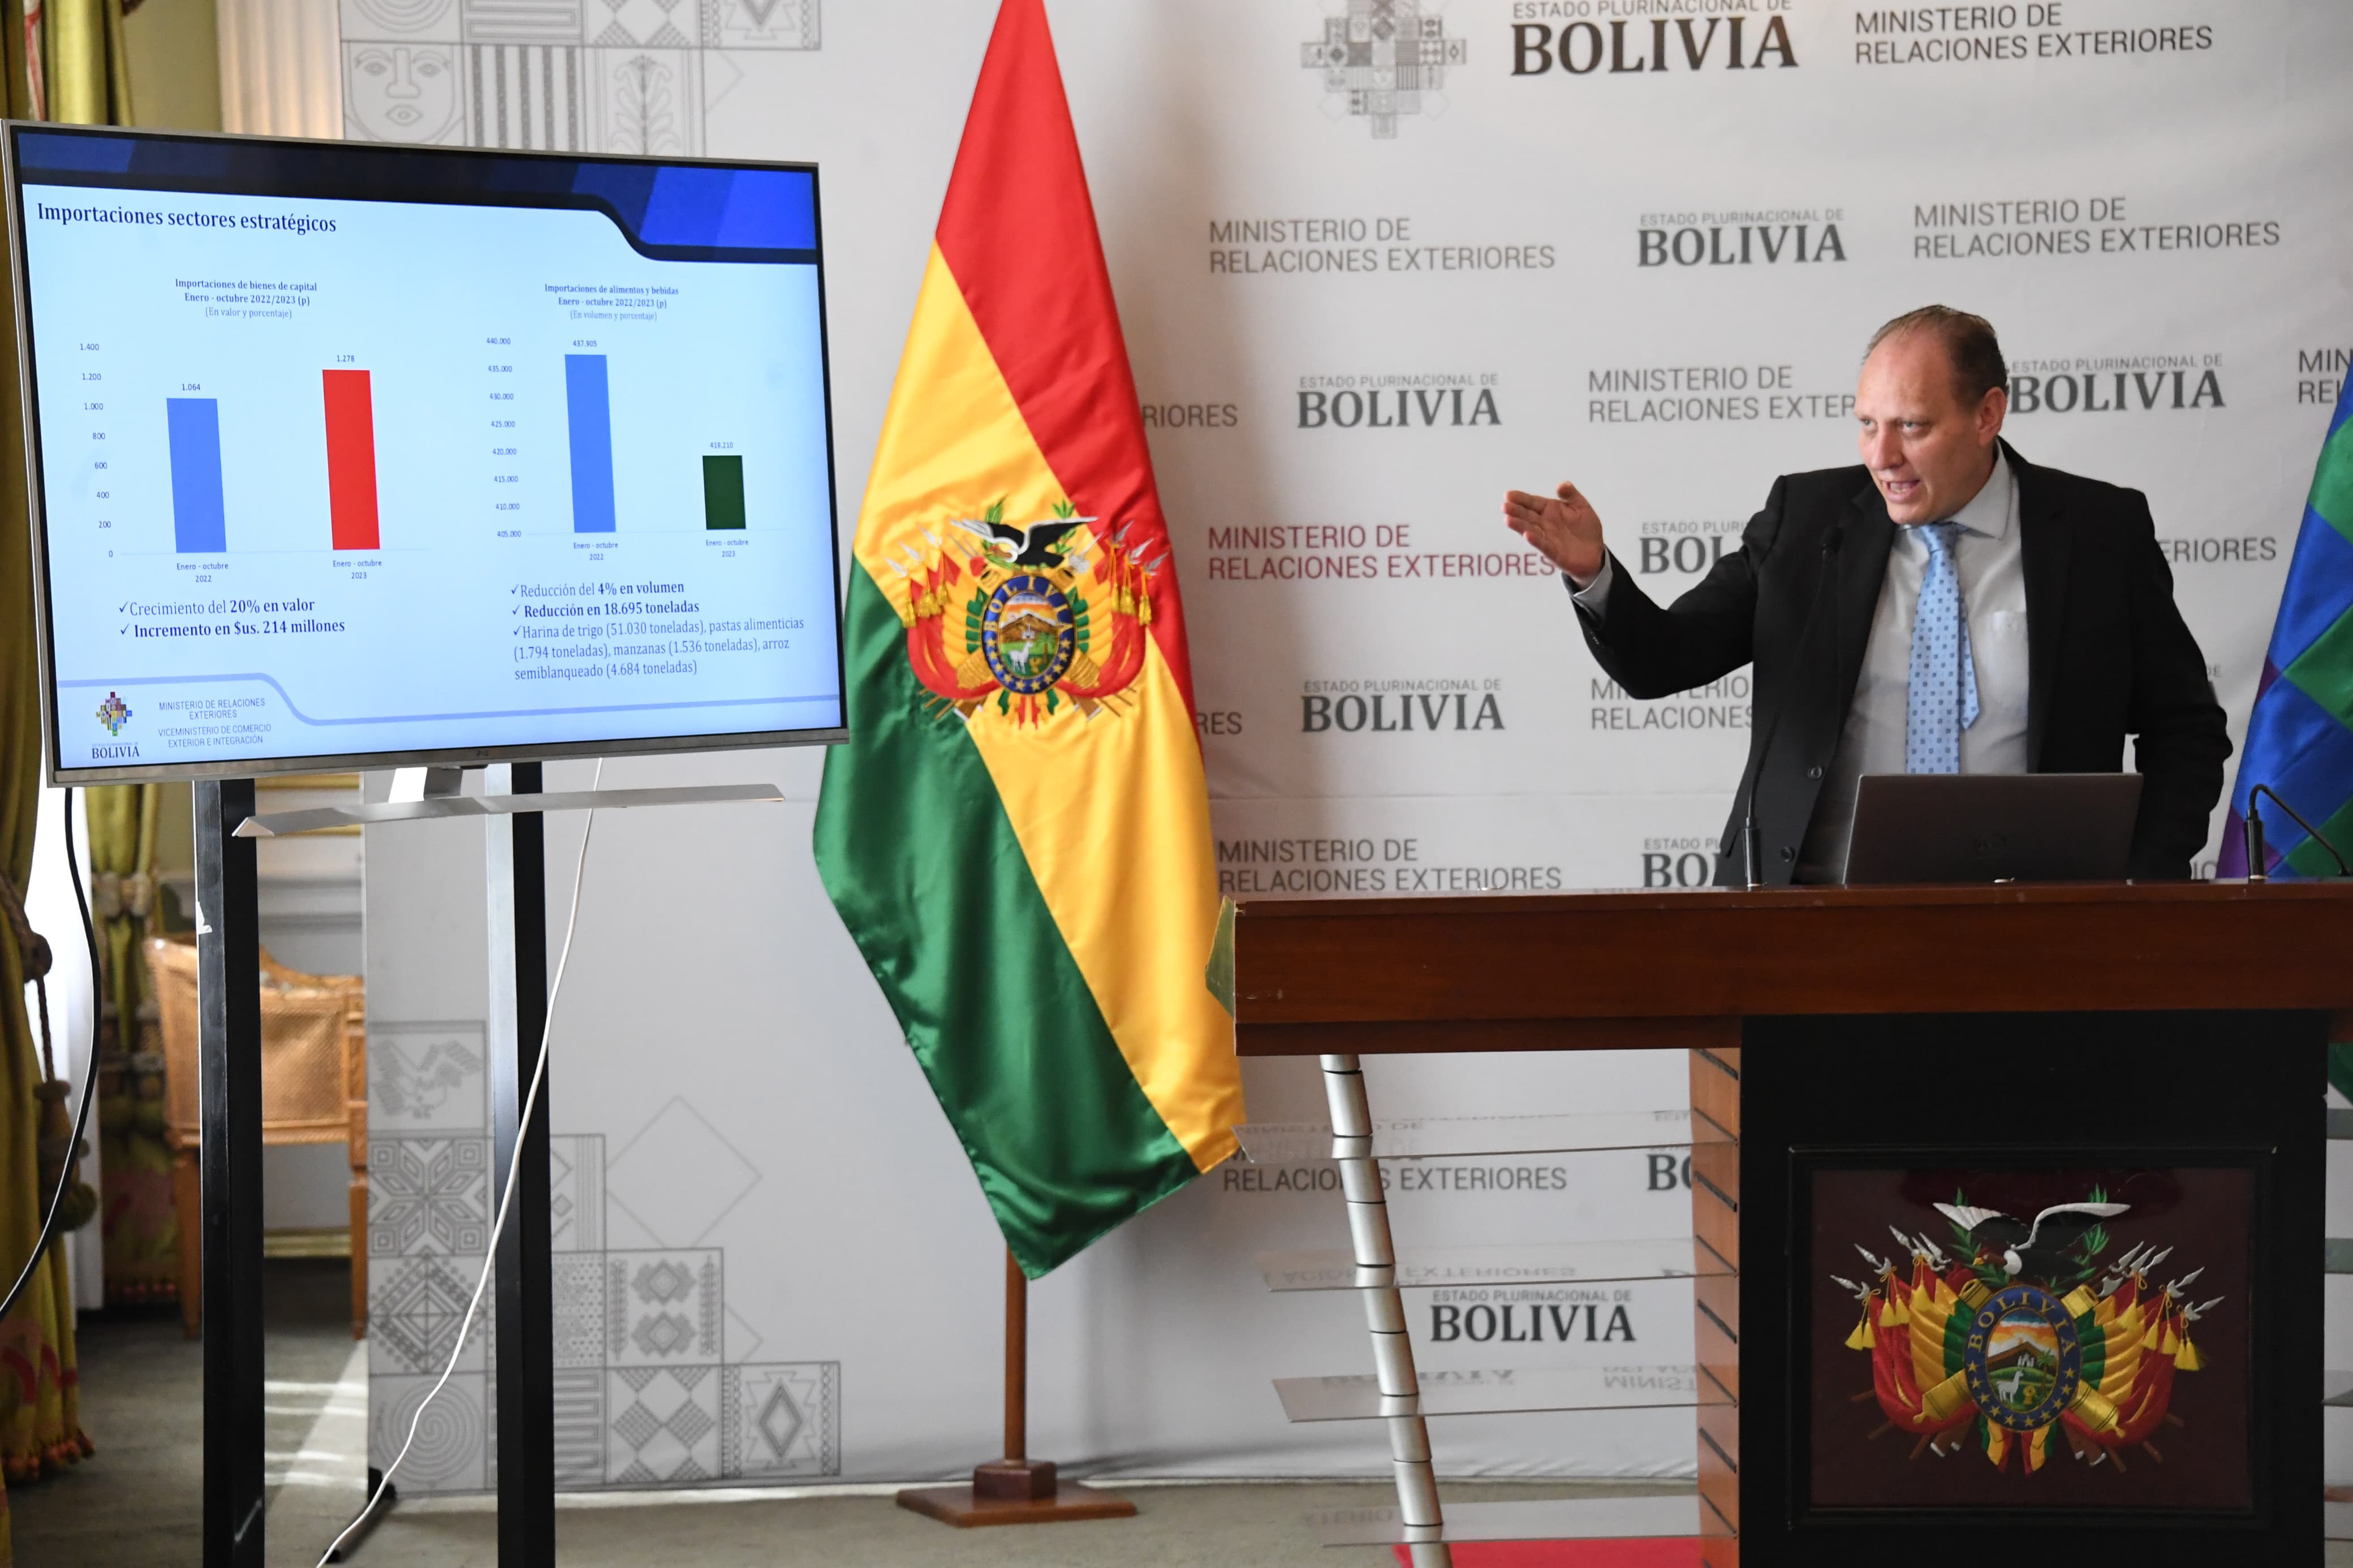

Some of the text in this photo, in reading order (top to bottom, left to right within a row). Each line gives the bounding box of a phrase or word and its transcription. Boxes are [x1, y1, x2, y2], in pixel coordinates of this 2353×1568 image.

[1514, 0, 1791, 19] ESTADO PLURINACIONAL DE
[1856, 3, 2061, 34] MINISTERIO DE
[1511, 15, 1799, 76] BOLIVIA
[1856, 25, 2212, 64] RELACIONES EXTERIORES
[38, 203, 335, 235] Importaciones sectores estratégicos
[1640, 208, 1843, 227] ESTADO PLURINACIONAL DE
[1915, 197, 2125, 227] MINISTERIO DE
[1210, 218, 1410, 243] MINISTERIO DE
[1915, 222, 2279, 258] RELACIONES EXTERIORES
[1637, 224, 1847, 267] BOLIVIA
[1210, 245, 1555, 273] RELACIONES EXTERIORES
[175, 278, 317, 293] Importaciones de bienes de capital
[545, 283, 679, 295] Importaciones de alimentos bebidas
[184, 292, 310, 306] Enero octubre 2022/2023 (p)
[558, 297, 667, 309] Enero octubre 2022/2023 (p)
[205, 306, 292, 320] (En valor porcentaje)
[583, 310, 657, 322] volumen porcentaje)
[2012, 354, 2222, 373] ESTADO PLURINACIONAL DE
[1300, 373, 1498, 388] ESTADO PLURINACIONAL DE
[1589, 366, 1791, 392] MINISTERIO DE
[2009, 369, 2226, 414] BOLIVIA
[84, 402, 104, 411] 1.000
[1297, 388, 1502, 429] BOLIVIA
[1589, 397, 1759, 422] RELACIONES
[1209, 525, 1410, 549] MINISTERIO DE
[1643, 521, 1699, 534] ESTADO
[202, 561, 229, 570] octubre
[357, 559, 382, 567] octubre
[1210, 553, 1555, 580] RELACIONES EXTERIORES
[195, 574, 212, 583] 2022
[520, 581, 684, 598] Reducción del 4% en volumen
[130, 598, 315, 616] Crecimiento del 20% en valor
[524, 600, 699, 618] Reducción en 18.695 toneladas
[135, 619, 345, 637] Incremento en $us. 214 millones
[523, 617, 804, 640] Harina de trigo (51.030 toneladas), pastas alimenticias
[514, 637, 790, 663] (1.794 toneladas), manzanas (1.536 toneladas), arroz
[515, 659, 697, 681] semiblanqueado (4.684 toneladas)
[1304, 679, 1501, 693] ESTADO PLURINACIONAL DE
[159, 698, 265, 711] MINISTERIO DE RELACIONES
[1301, 693, 1505, 733] BOLIVIA
[189, 709, 238, 720] EXTERIORES
[158, 723, 272, 737] VICEMINISTERIO DE COMERCIO
[168, 733, 263, 748] EXTERIOR INTEGRACIÓN
[92, 746, 140, 759] BOLIVIA
[1218, 839, 1417, 863] MINISTERIO DE
[1644, 838, 1700, 850] ESTADO
[1219, 867, 1561, 893] RELACIONES EXTERIORES
[1400, 1167, 1567, 1190] EXTERIORES
[1433, 1289, 1631, 1303] ESTADO PLURINACIONAL DE
[1430, 1304, 1636, 1342] BOLIVIA
[1968, 1292, 2076, 1357] BOLIVIA
